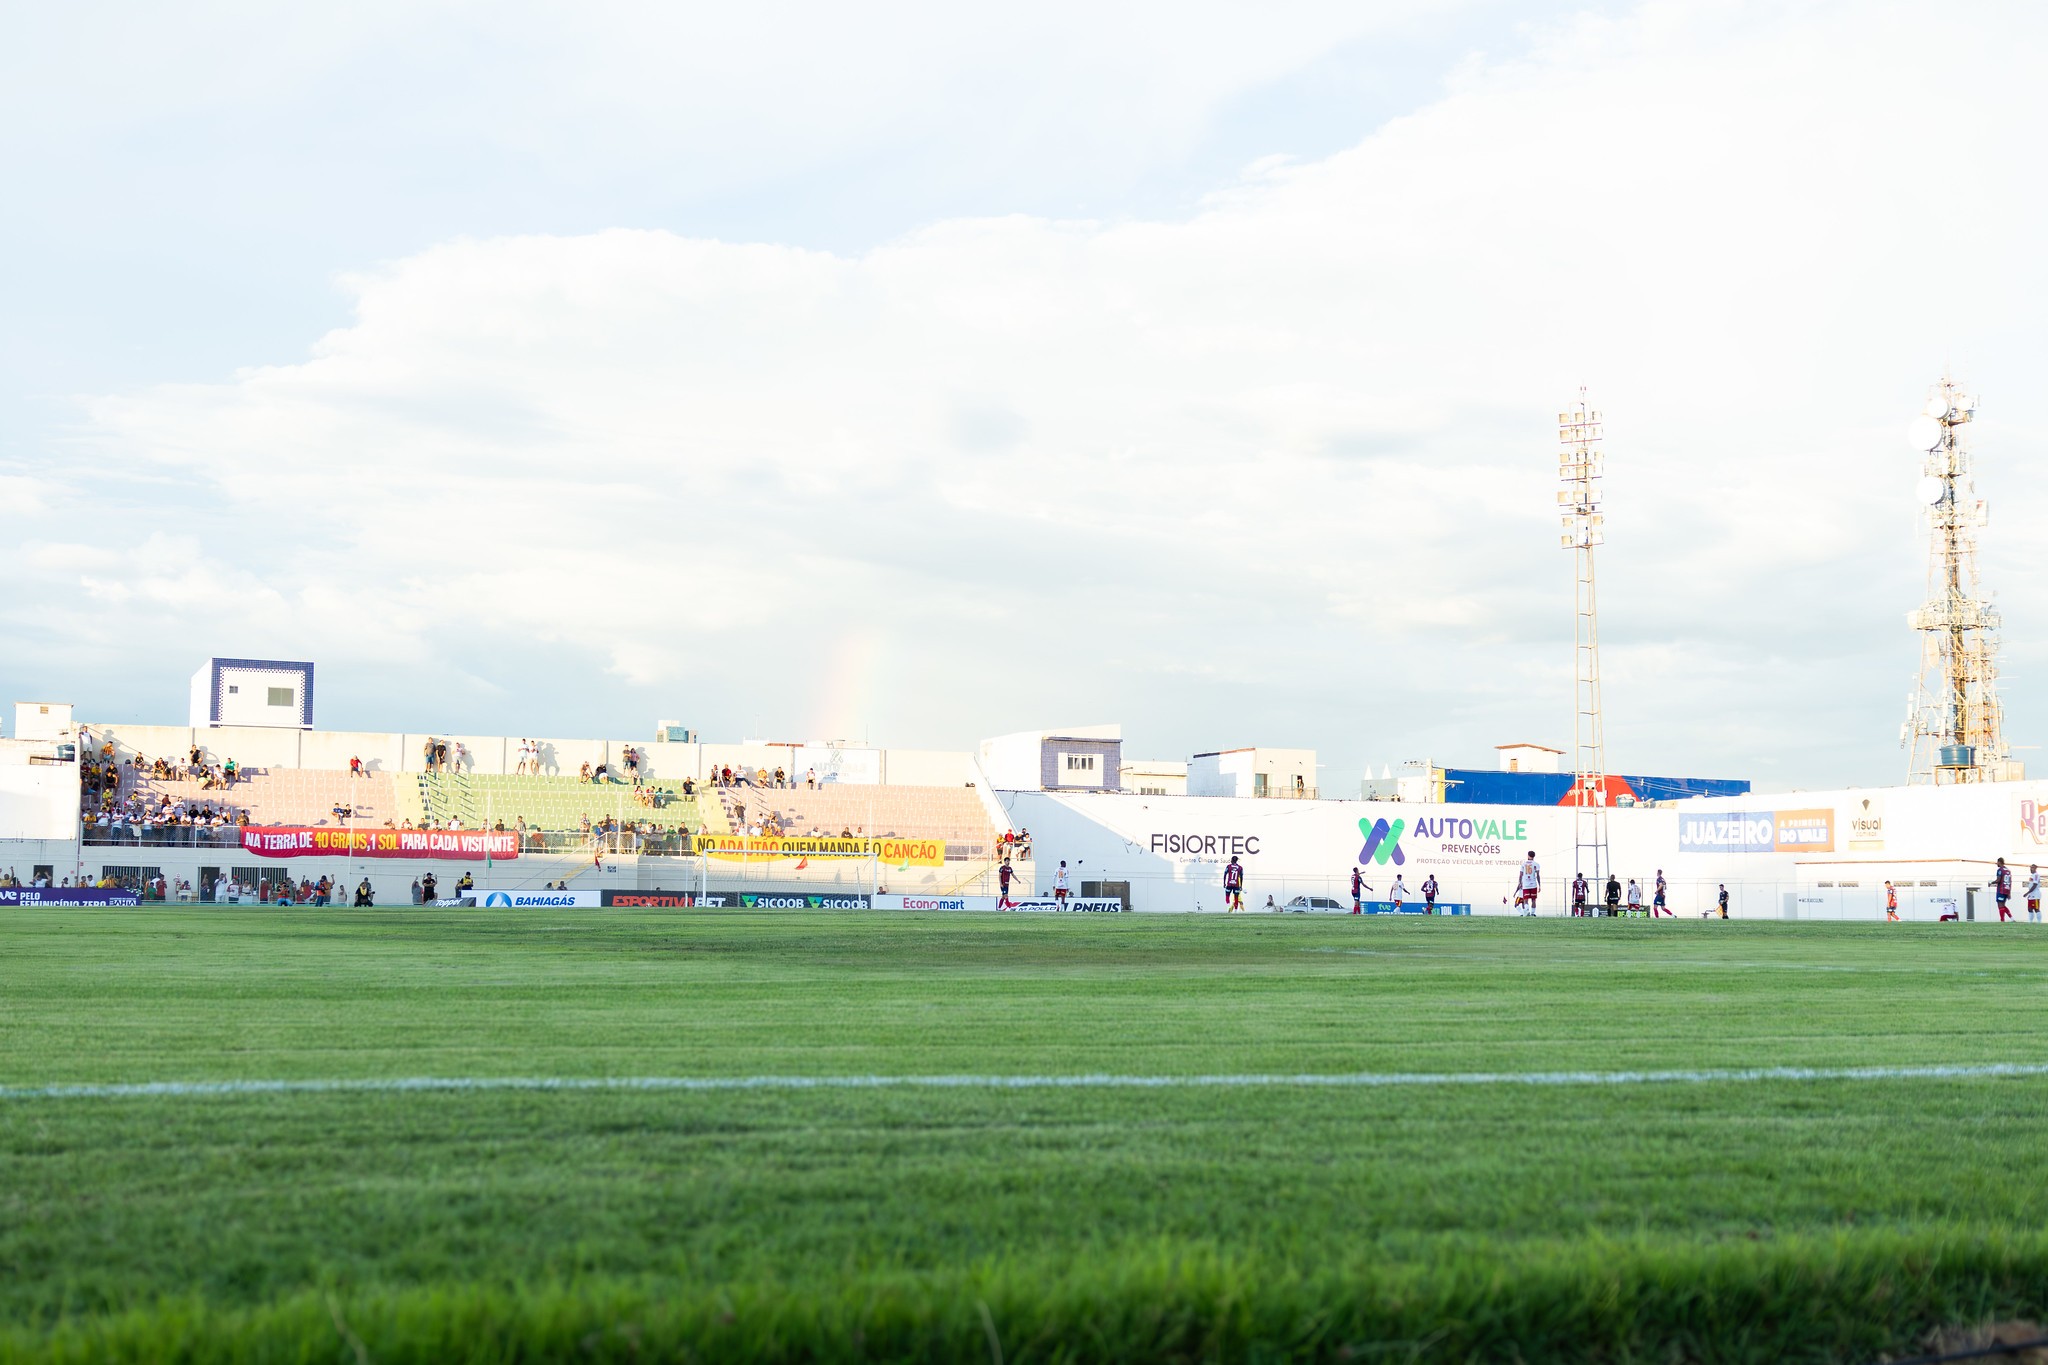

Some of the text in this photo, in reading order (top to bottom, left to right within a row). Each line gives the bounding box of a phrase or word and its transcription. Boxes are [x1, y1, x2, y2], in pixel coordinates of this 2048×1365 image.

[1413, 817, 1528, 841] AUTOVALE
[1788, 818, 1827, 827] PRIMEIRA
[1852, 817, 1882, 830] visual
[1681, 819, 1773, 845] JUAZEIRO
[1779, 828, 1827, 843] DO VALE
[245, 832, 261, 848] NA
[263, 834, 298, 850] TERRA
[299, 831, 313, 849] DE
[314, 831, 329, 849] 40
[378, 833, 400, 850] SOL
[401, 833, 429, 850] PARA
[430, 834, 459, 851] CADA
[460, 836, 514, 852] VISITANTE
[697, 837, 716, 853] NO
[781, 841, 817, 858] QUEM
[819, 841, 860, 857] MANDA
[872, 842, 882, 858] O
[1151, 833, 1261, 855] FISIORTEC
[1441, 842, 1501, 856] PREVENÇÕES
[20, 892, 40, 900] PELO
[515, 894, 575, 906] BAHIAGÁS
[757, 898, 868, 909] SICOOB SICOOB
[903, 897, 965, 910] Economart
[1072, 902, 1121, 912] PNEUS
